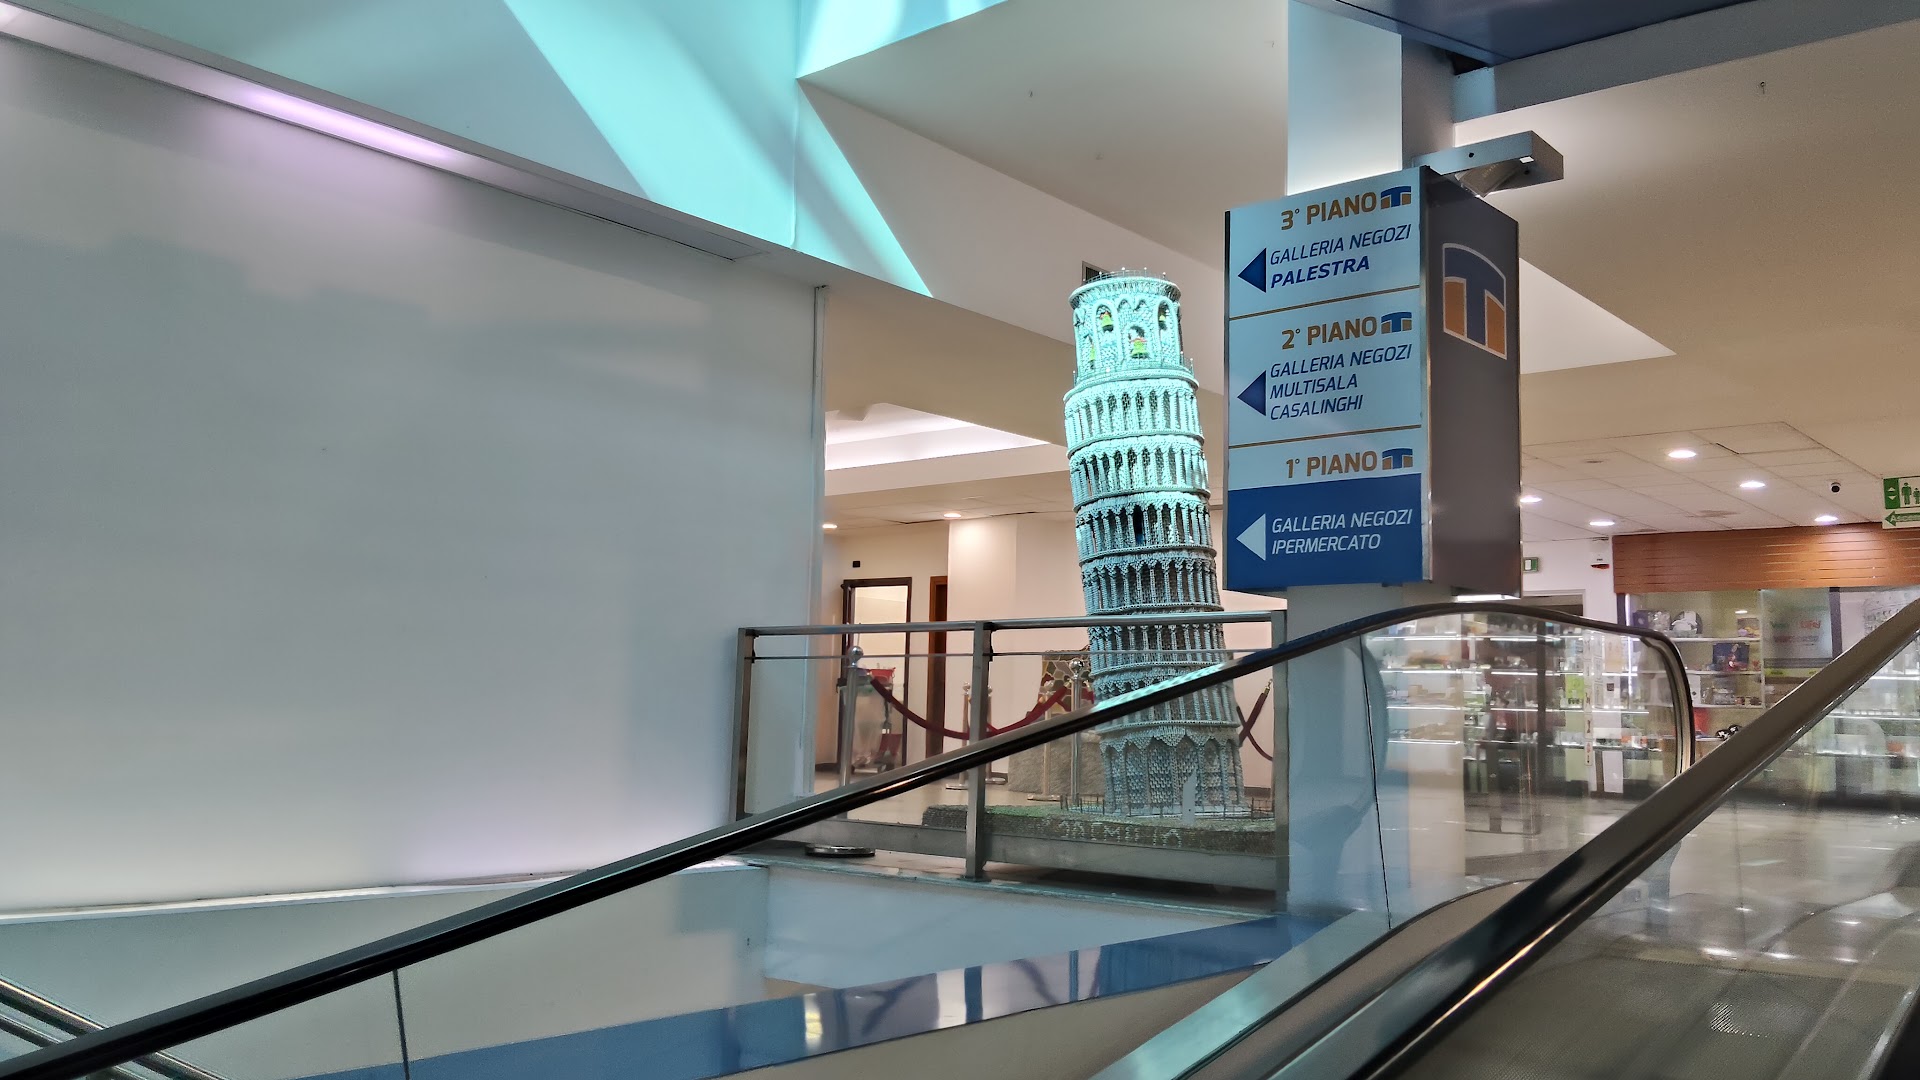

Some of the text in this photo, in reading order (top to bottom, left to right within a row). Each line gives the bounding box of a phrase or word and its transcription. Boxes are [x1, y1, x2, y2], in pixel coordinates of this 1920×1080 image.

[1281, 192, 1377, 230] 3° PIANO
[1270, 224, 1411, 265] GALLERIA NEGOZI
[1270, 256, 1370, 288] PALESTRA
[1282, 316, 1377, 350] 2° PIANO
[1270, 344, 1412, 378] GALLERIA NEGOZI
[1270, 373, 1358, 400] MULTISALA
[1270, 394, 1363, 420] CASALINGHI
[1286, 450, 1377, 478] 1° PIANO
[1272, 508, 1412, 534] GALLERIA NEGOZI
[1272, 534, 1381, 555] IPERMERCATO
